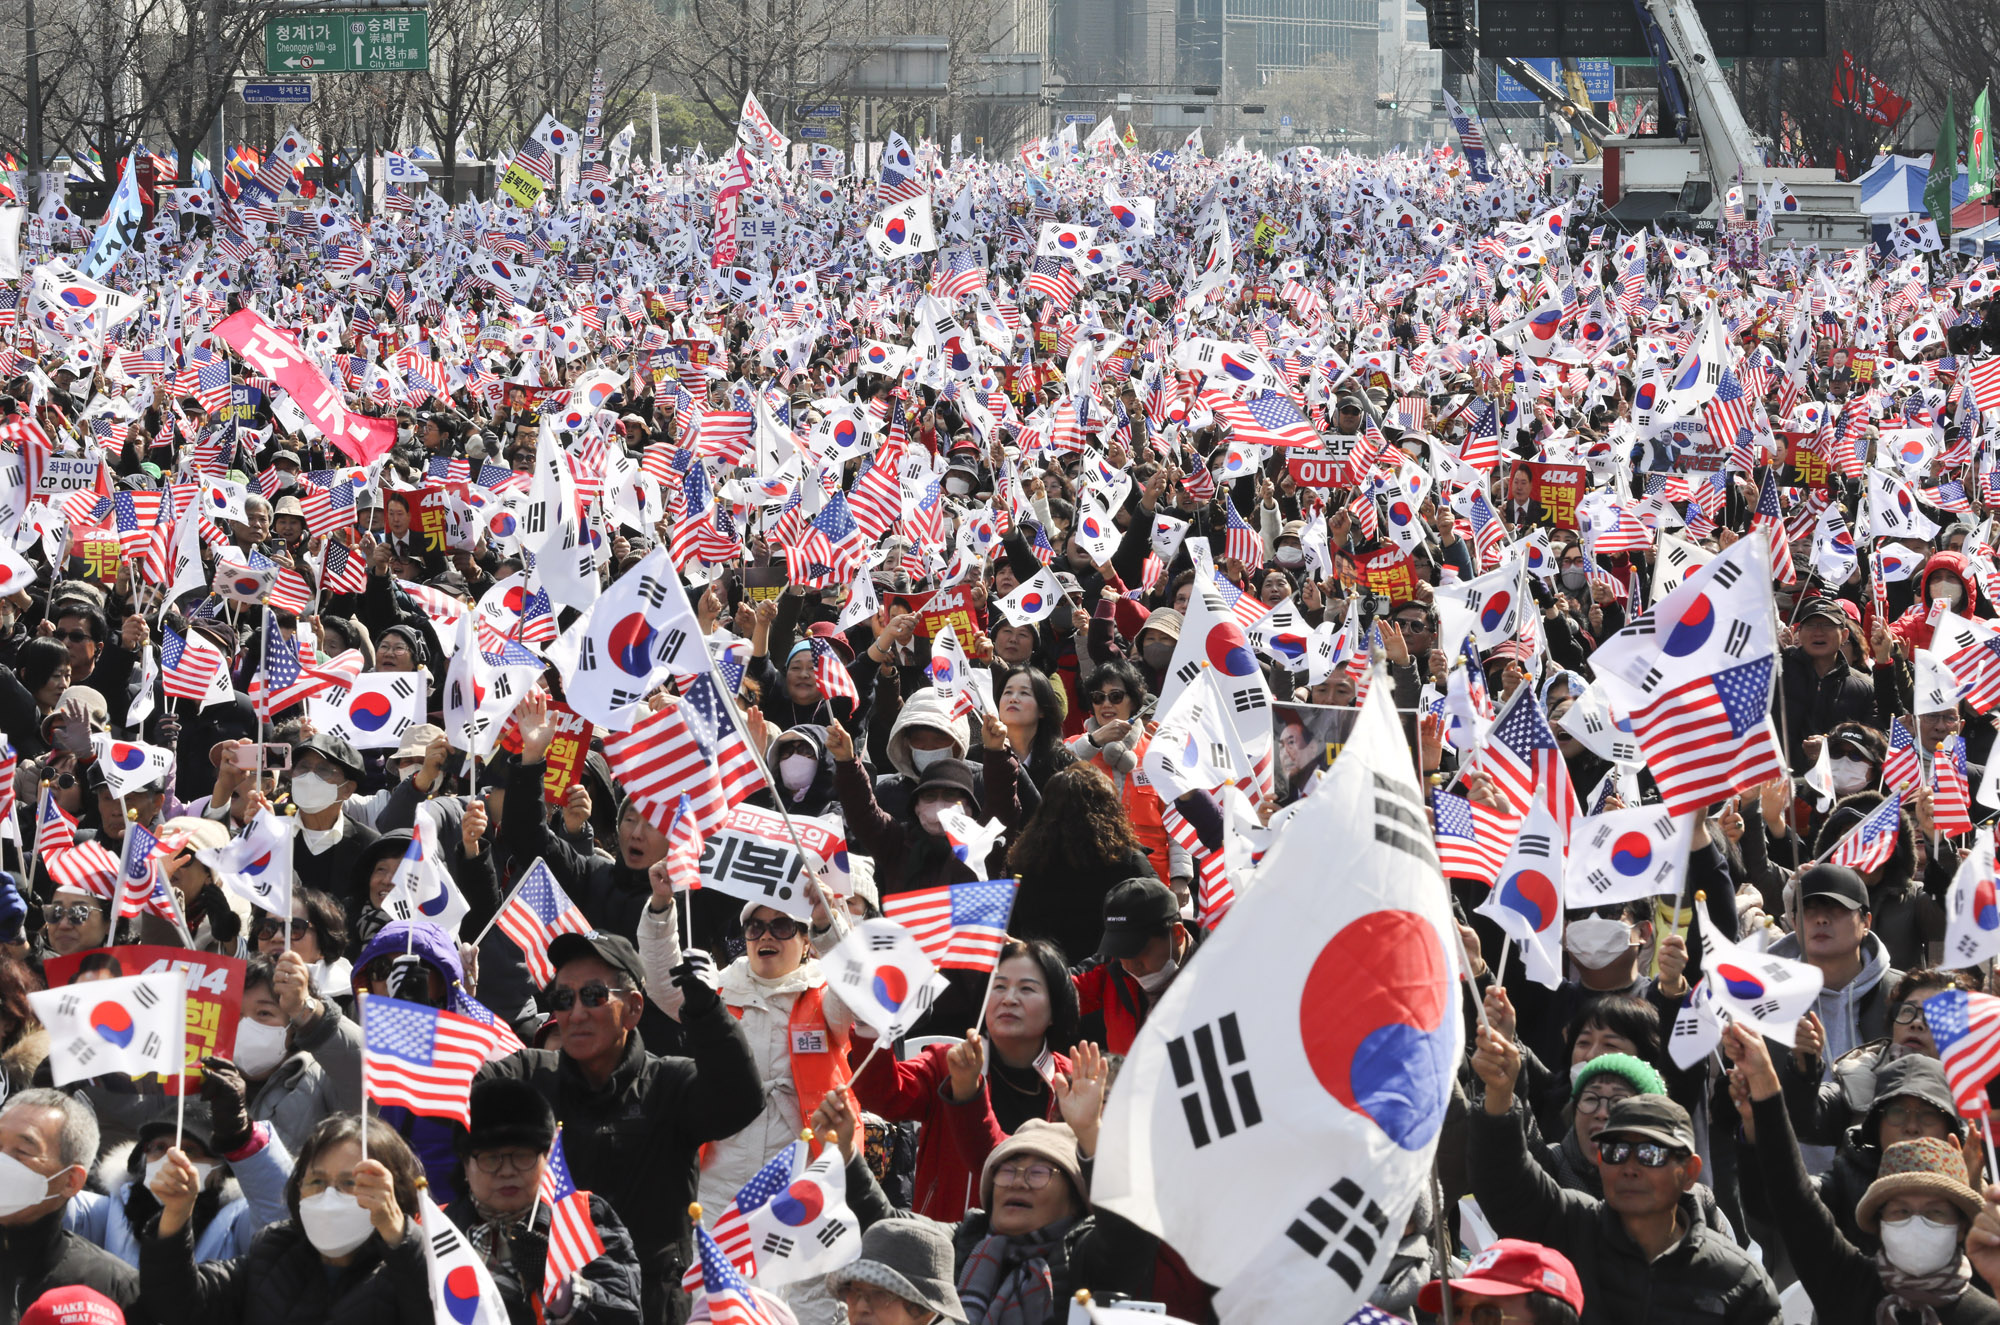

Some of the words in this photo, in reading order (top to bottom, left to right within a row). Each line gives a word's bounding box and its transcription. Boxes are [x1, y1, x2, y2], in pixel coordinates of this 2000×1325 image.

[353, 23, 363, 33] 60
[368, 17, 411, 32] 숭례문
[276, 24, 330, 41] 청계1가
[276, 42, 314, 54] Cheonggye
[369, 60, 386, 70] City
[389, 60, 404, 68] Hall
[1578, 62, 1610, 71] 서소문로
[278, 87, 310, 95] 청계천로
[1585, 79, 1610, 89] 수궁길
[745, 100, 783, 148] STOP
[504, 170, 540, 201] 충북진천
[741, 220, 777, 237] 전북
[1039, 331, 1058, 342] 탄핵
[1039, 341, 1058, 352] 기각
[650, 350, 676, 369] 국회
[1854, 352, 1876, 360] 4대4
[1852, 359, 1874, 371] 탄핵
[1850, 369, 1872, 381] 기각
[232, 389, 249, 404] 회
[1673, 421, 1708, 433] REEDO
[1325, 440, 1355, 456] 보도
[1695, 443, 1723, 455] NOT
[49, 461, 73, 475] 좌파
[1673, 455, 1726, 472] FREE
[1300, 462, 1346, 483] OUT
[1541, 470, 1578, 484] 4대4
[1794, 468, 1828, 484] 기각
[37, 476, 57, 490] CP
[60, 477, 92, 490] OUT
[1540, 485, 1577, 506] 탄핵
[421, 510, 446, 533] 탄
[1540, 504, 1575, 526] 기각
[423, 532, 446, 552] 기
[83, 541, 120, 560] 탄핵
[1367, 548, 1405, 570] 4대4
[83, 559, 119, 578] 기각
[1367, 564, 1413, 587] 탄핵
[924, 592, 965, 612] 4대4
[556, 711, 584, 735] 대4
[1841, 731, 1863, 740] PING
[544, 737, 579, 768] 핵
[699, 836, 805, 901] 회복!
[185, 1001, 222, 1048] 핵
[797, 1036, 823, 1051] 헌금
[52, 1301, 84, 1316] MAKE
[60, 1313, 89, 1324] GREAT
